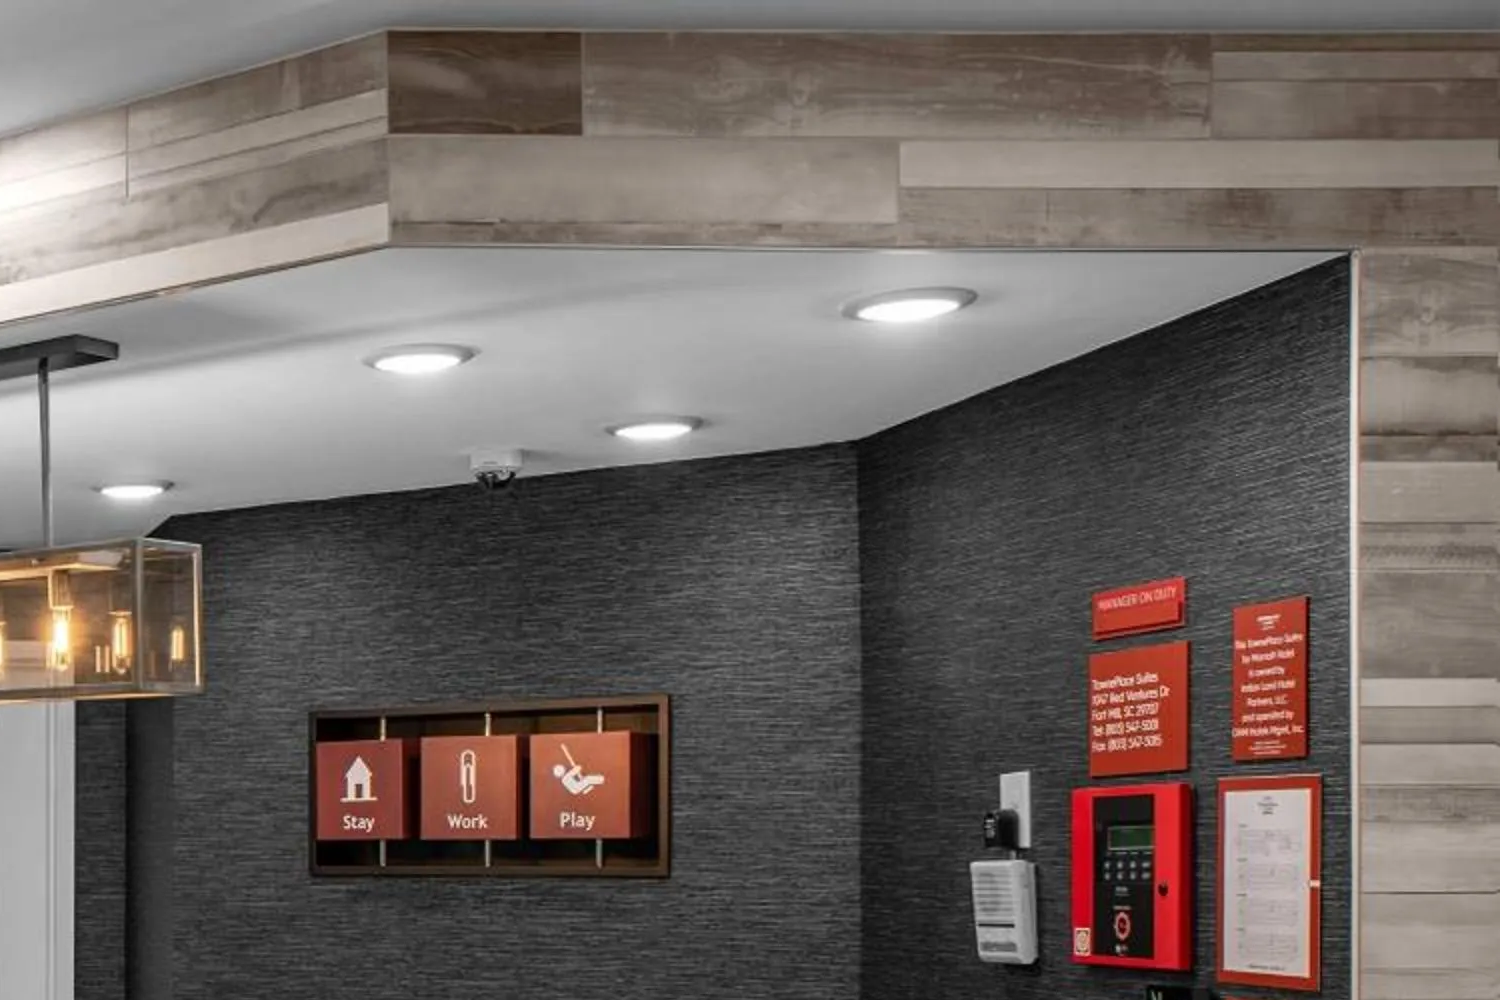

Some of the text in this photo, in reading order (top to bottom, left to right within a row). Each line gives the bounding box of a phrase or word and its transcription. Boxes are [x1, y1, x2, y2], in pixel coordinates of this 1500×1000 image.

[1140, 591, 1153, 604] ON
[1154, 586, 1177, 600] DUTY
[1135, 672, 1159, 684] Suites
[1160, 684, 1171, 698] Dr
[1091, 708, 1107, 720] Fort
[1123, 705, 1135, 718] SC
[343, 815, 375, 832] Stay
[448, 814, 488, 829] Work
[559, 812, 597, 832] Play
